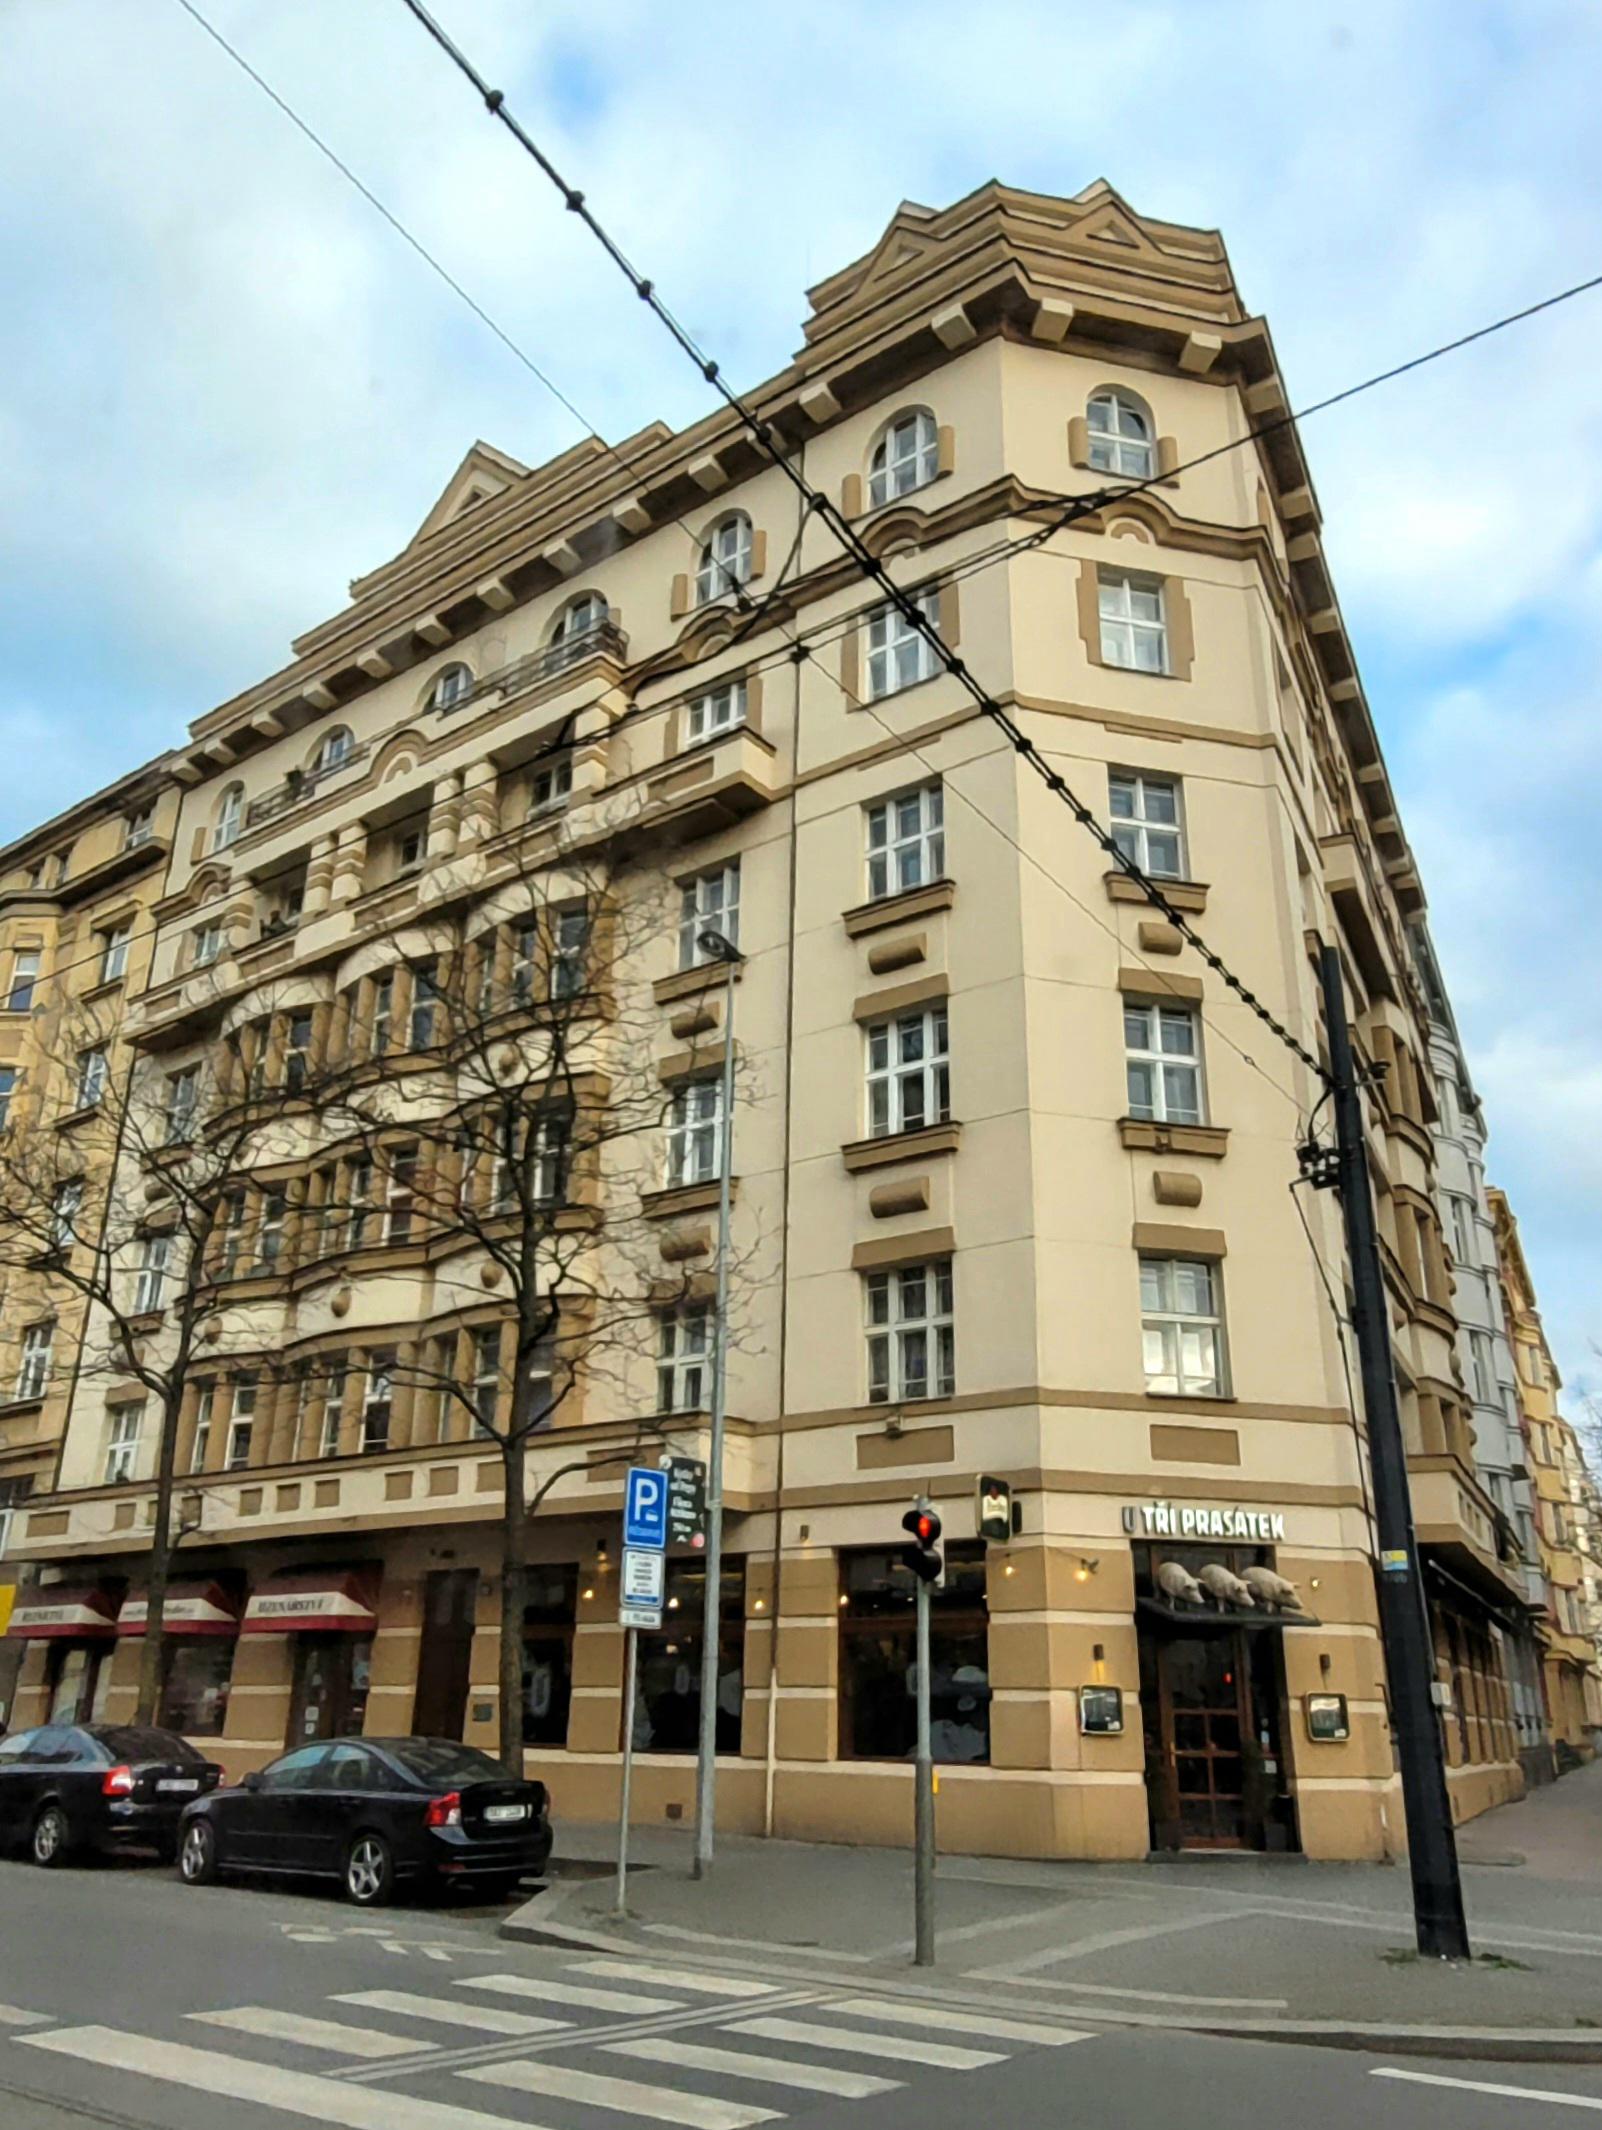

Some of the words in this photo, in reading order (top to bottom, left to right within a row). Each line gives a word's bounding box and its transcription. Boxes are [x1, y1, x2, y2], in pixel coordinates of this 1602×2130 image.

[634, 1478, 659, 1521] P
[1122, 1506, 1135, 1533] U
[1180, 1507, 1285, 1541] PRASÁTEK
